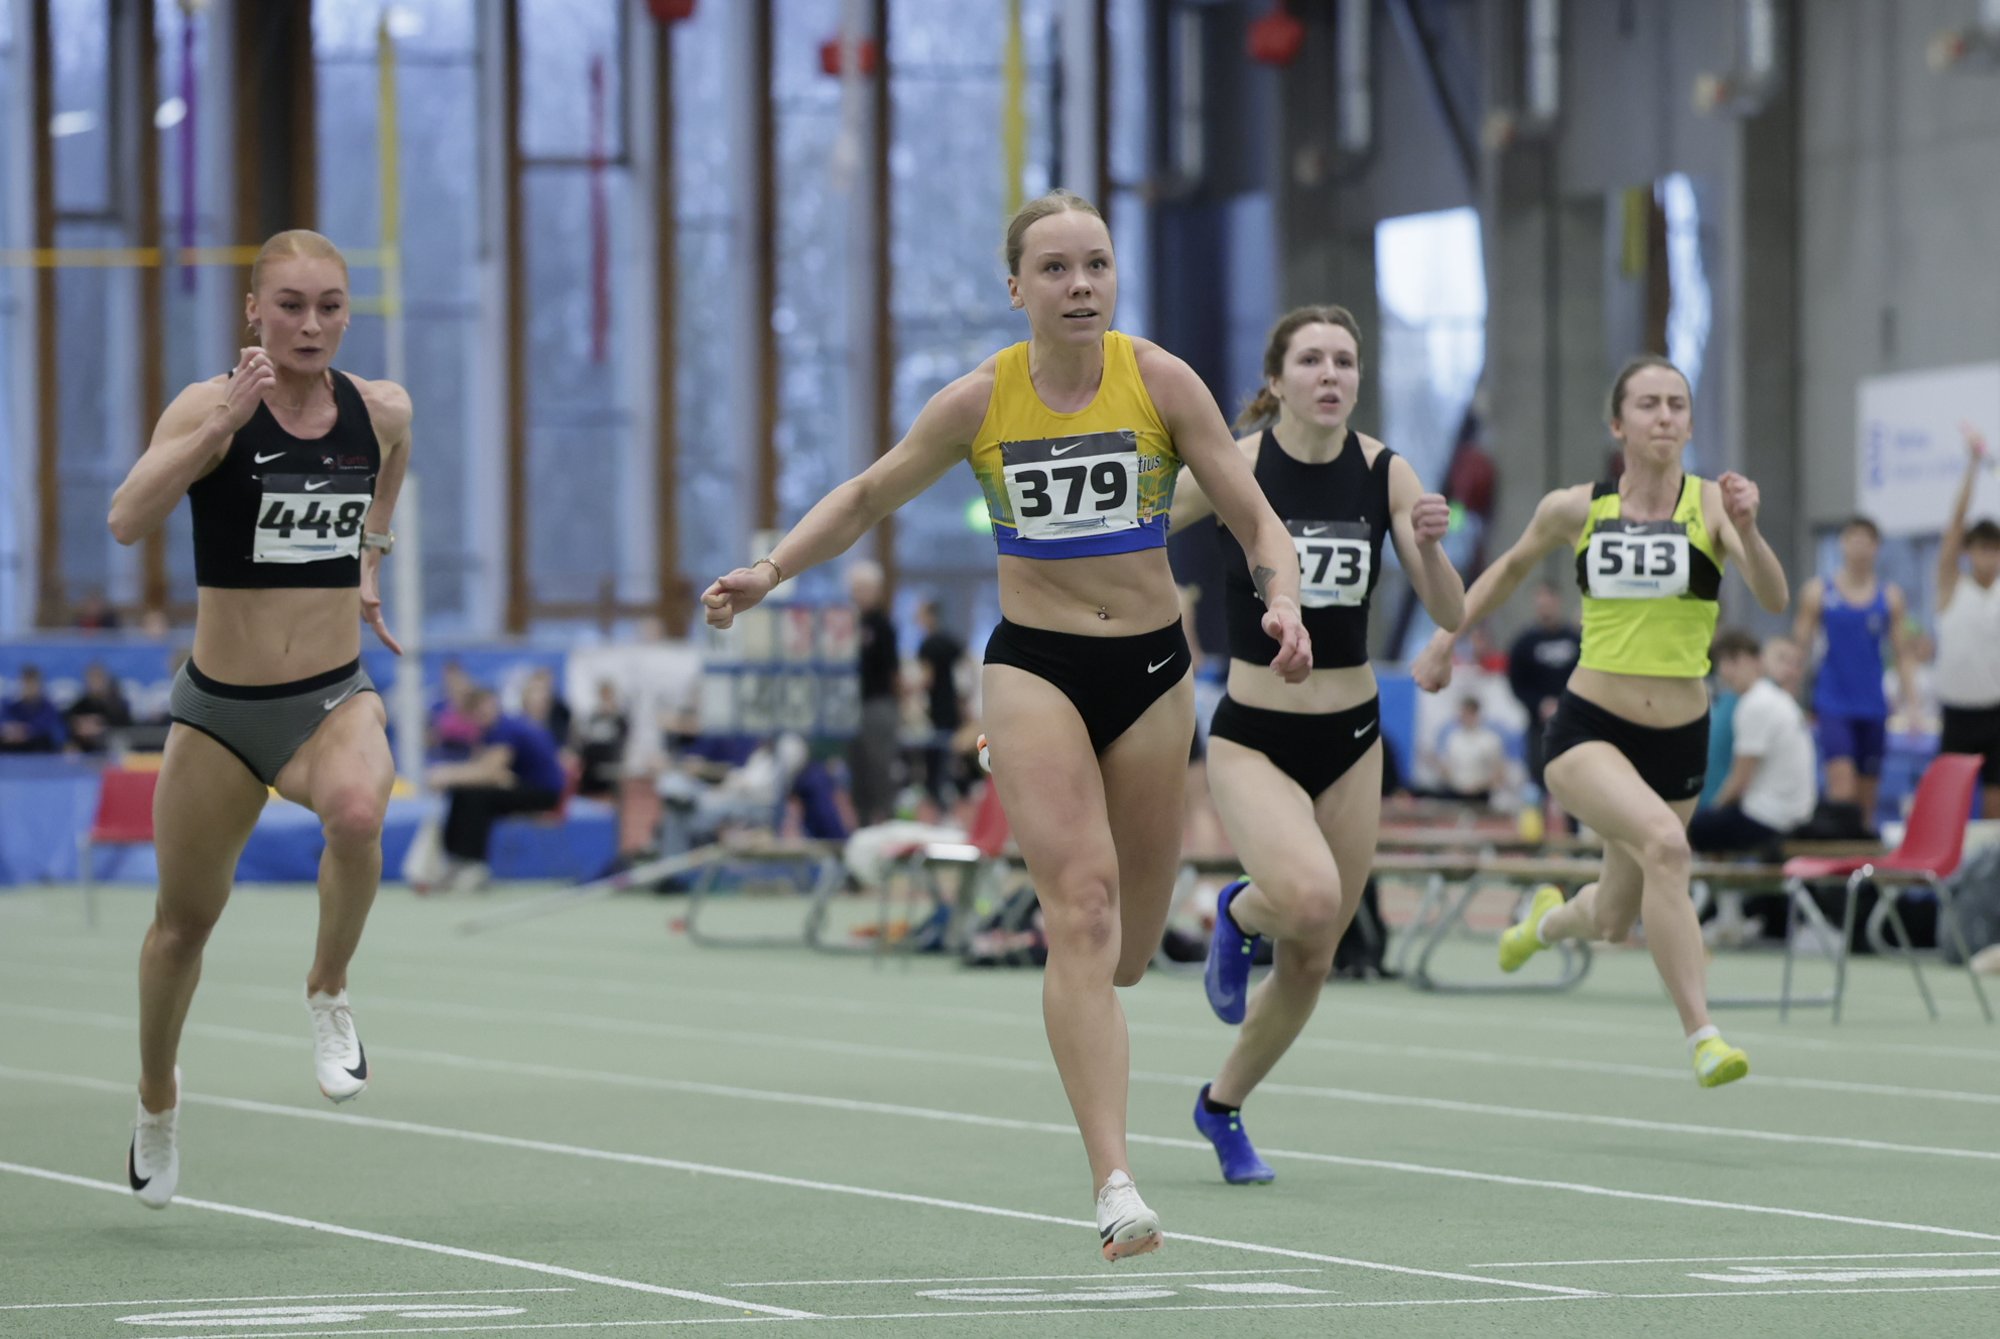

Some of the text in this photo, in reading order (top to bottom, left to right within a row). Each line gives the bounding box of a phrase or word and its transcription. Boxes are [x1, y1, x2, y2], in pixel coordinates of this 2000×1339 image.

[1014, 461, 1127, 518] 379
[259, 501, 365, 538] 448
[1297, 546, 1361, 586] 73
[1598, 541, 1676, 576] 513
